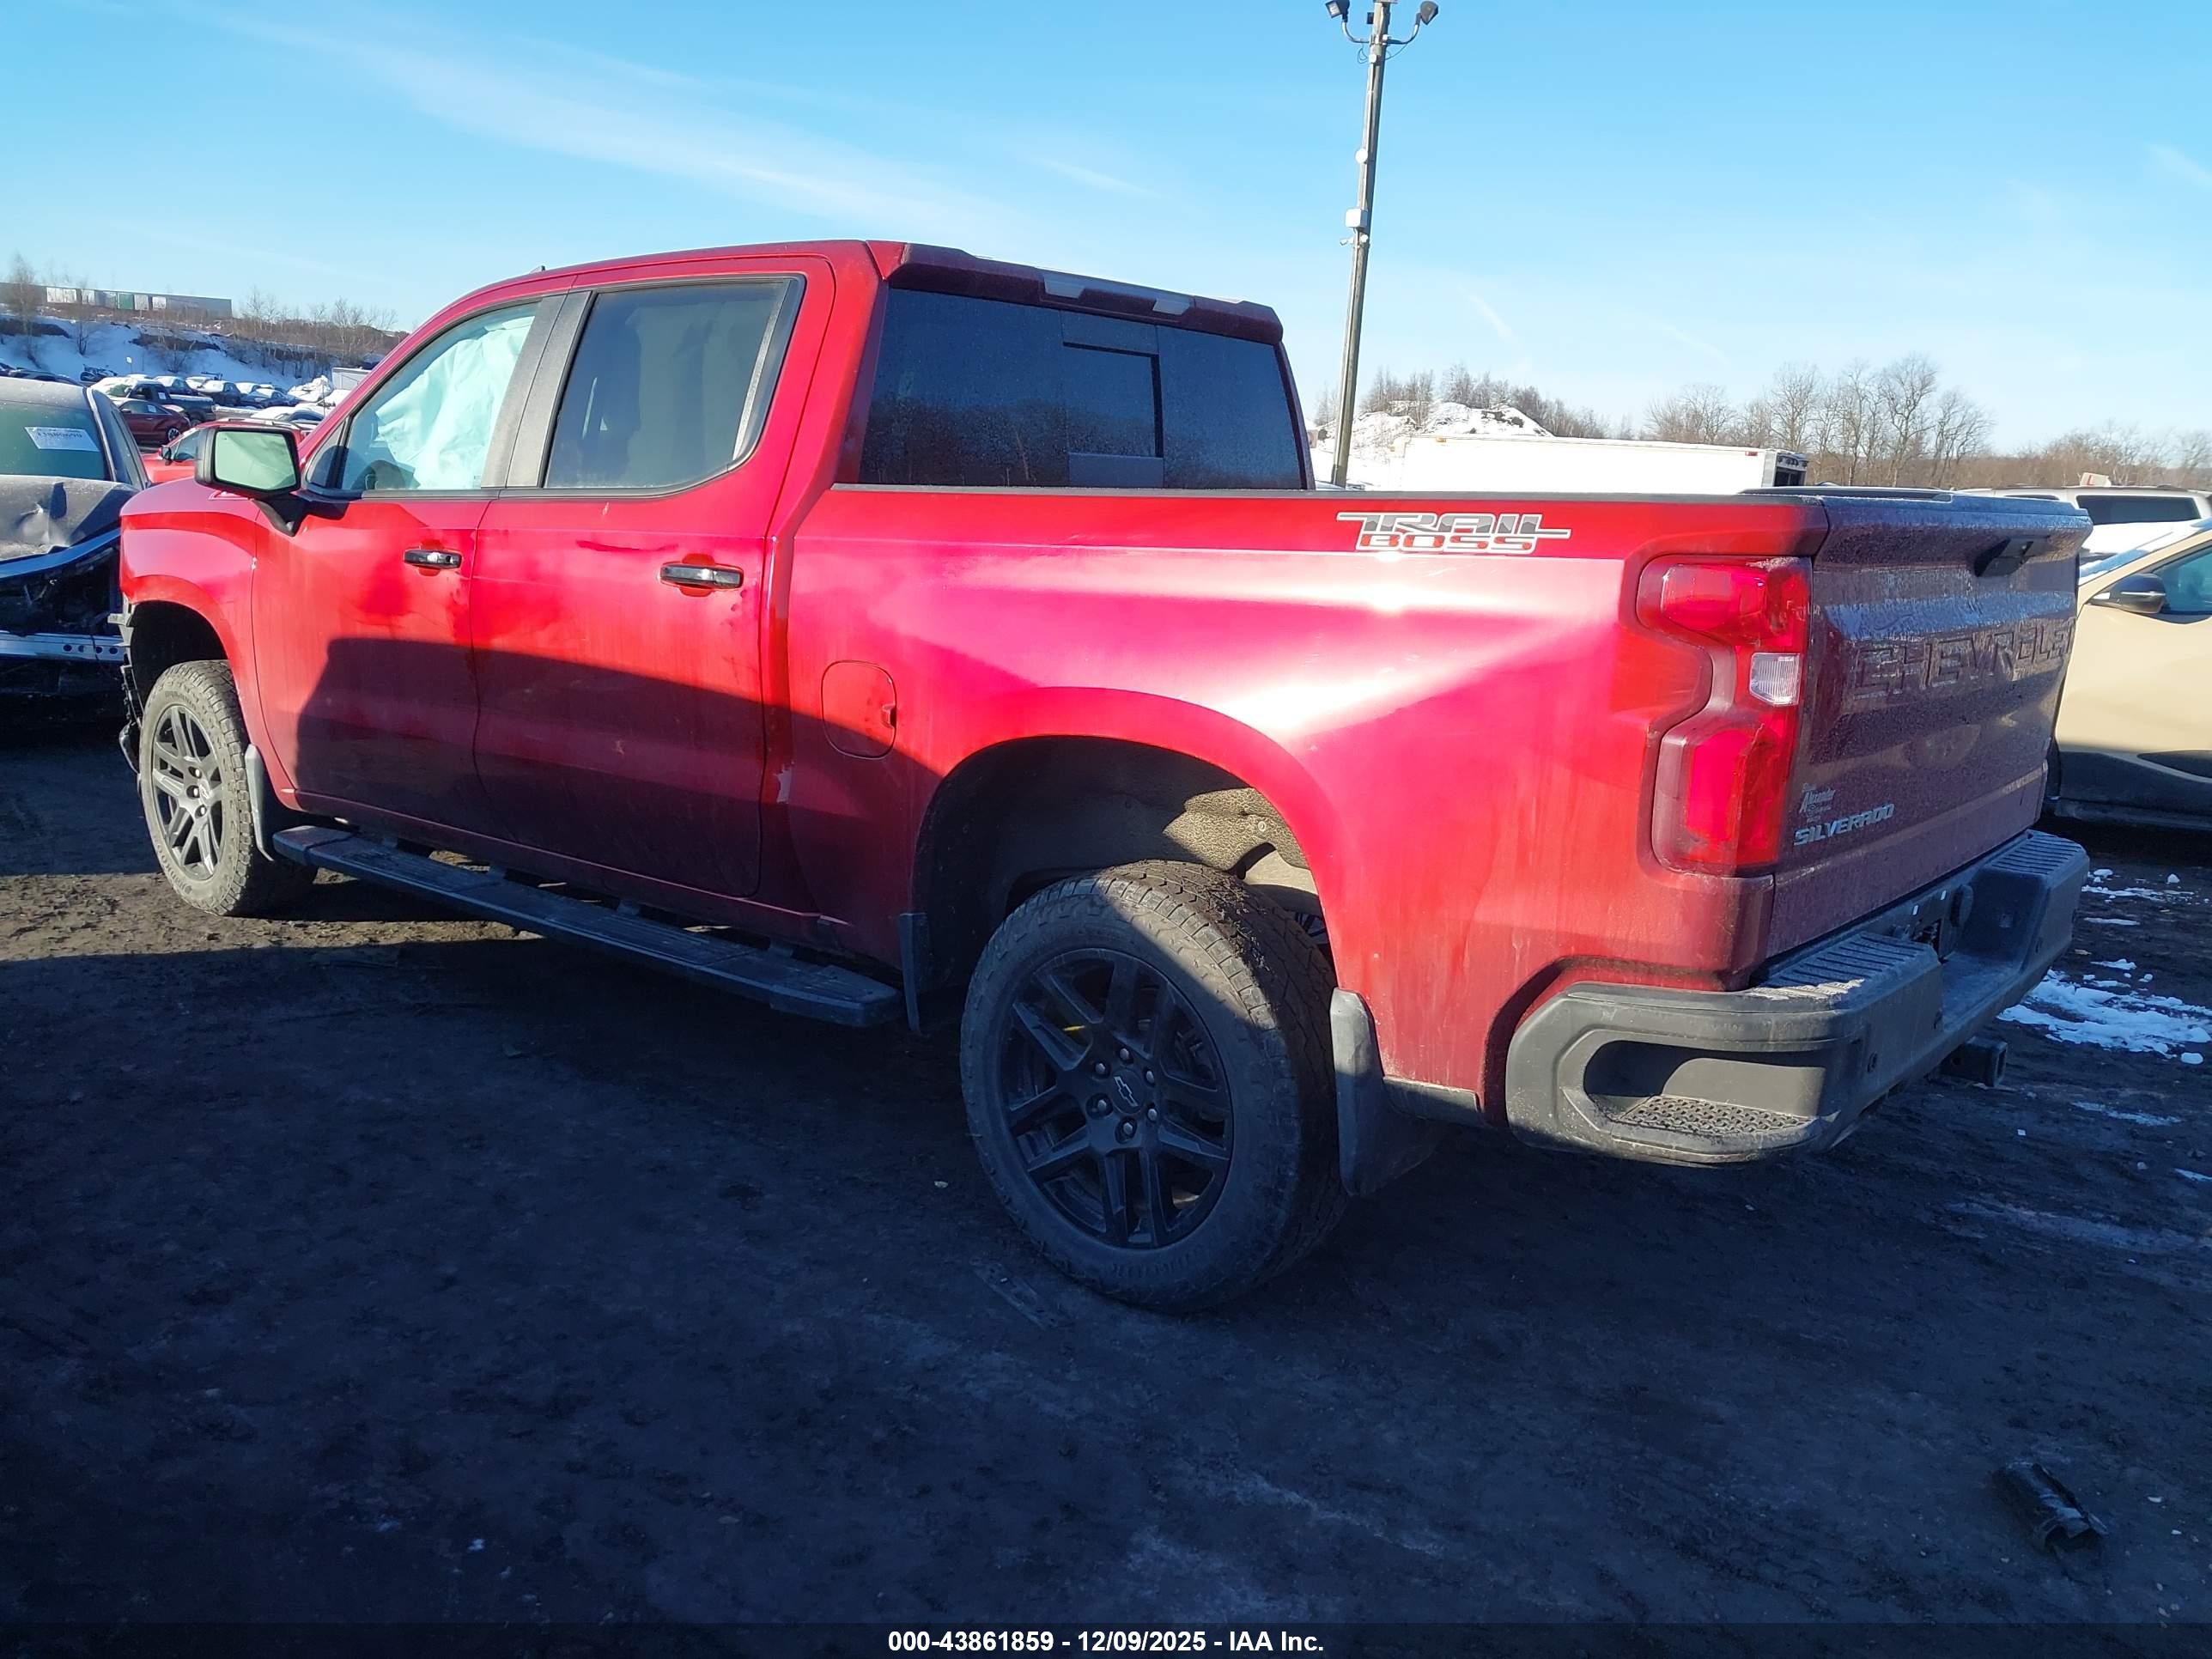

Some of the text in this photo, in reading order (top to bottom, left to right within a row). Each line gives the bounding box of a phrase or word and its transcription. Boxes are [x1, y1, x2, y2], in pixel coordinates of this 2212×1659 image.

[1336, 512, 1572, 540] TRAIL
[1356, 532, 1537, 556] BOSS
[1793, 803, 1895, 846] SILVERADO
